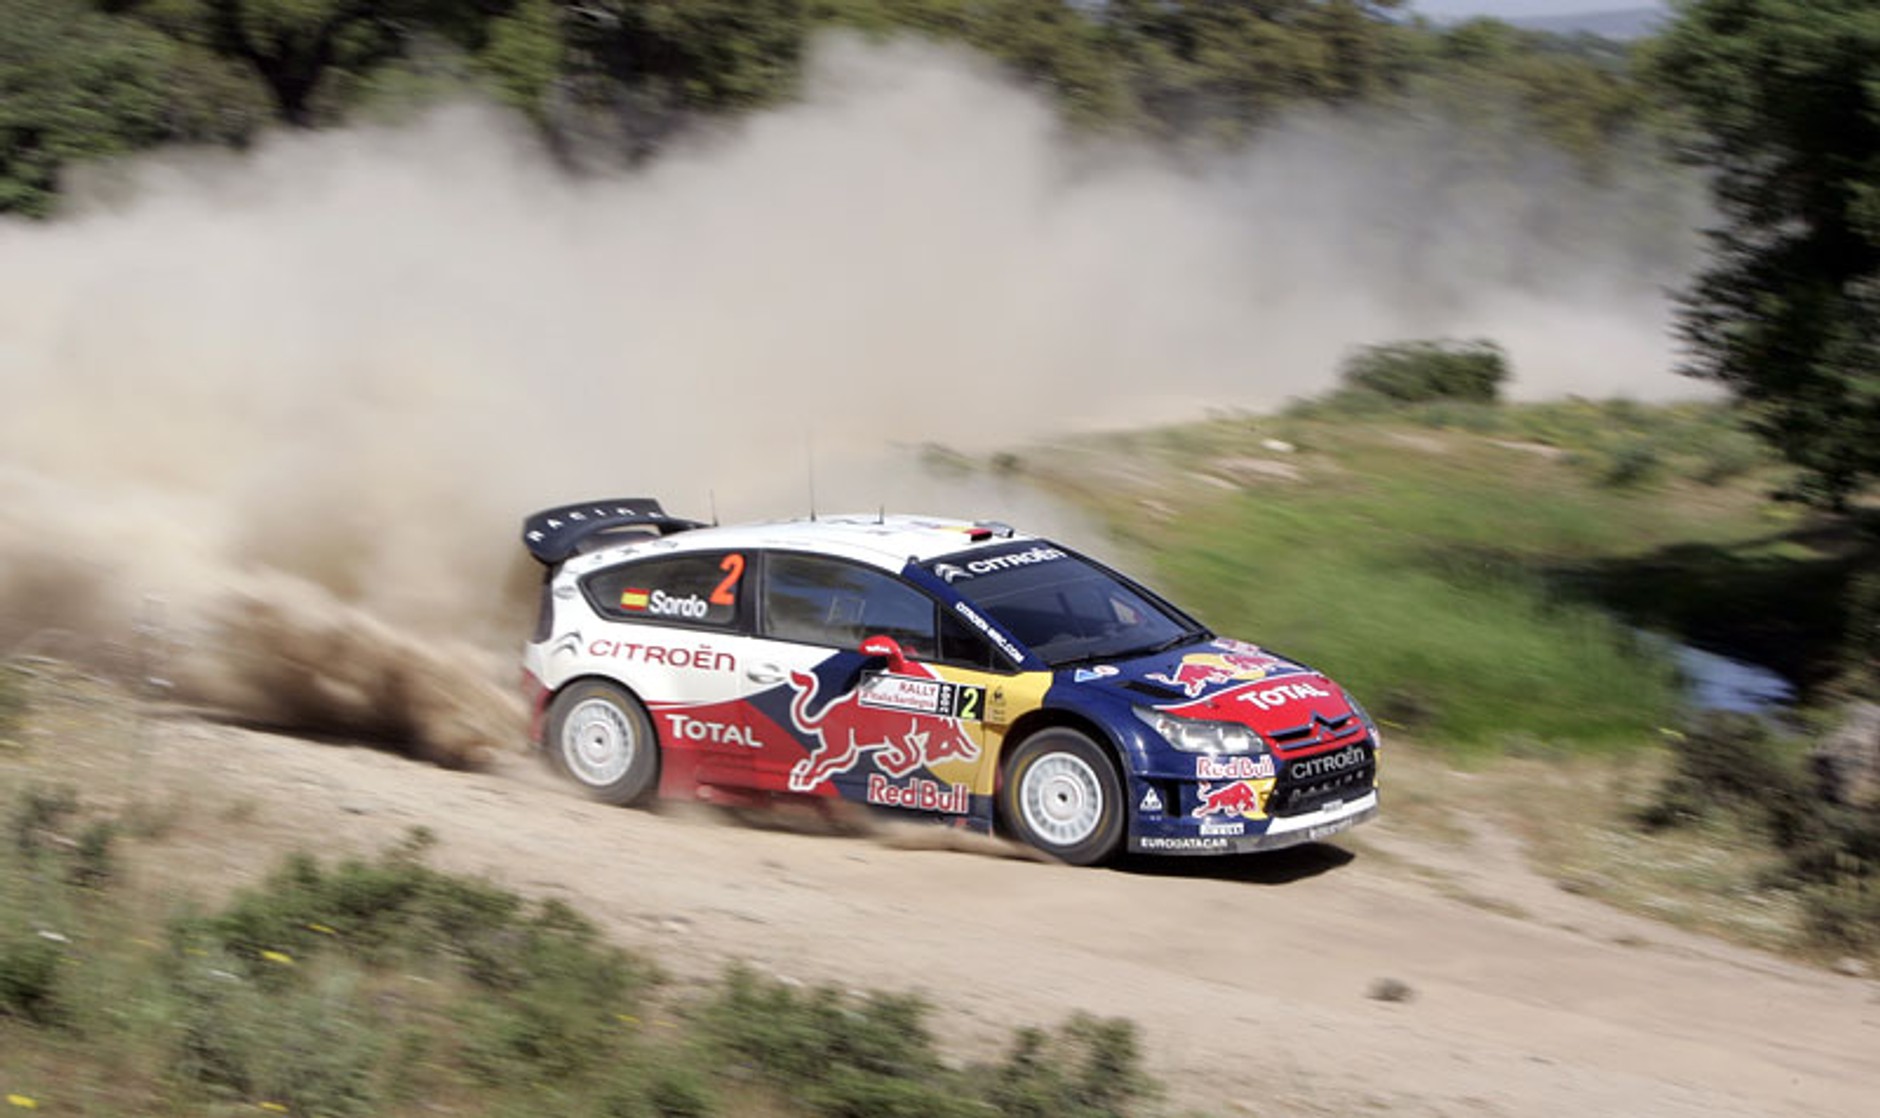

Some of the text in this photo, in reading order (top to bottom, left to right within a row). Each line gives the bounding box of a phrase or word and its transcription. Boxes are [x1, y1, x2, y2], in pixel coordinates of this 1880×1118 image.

[709, 553, 744, 605] 2
[649, 590, 708, 618] Sordo
[589, 639, 736, 672] CITROËN
[900, 681, 937, 697] RALLY
[960, 688, 979, 719] 2
[1237, 682, 1330, 710] TOTAL
[665, 713, 764, 748] TOTAL
[1196, 754, 1275, 778] Red Bull
[1292, 745, 1364, 779] CITROËN
[867, 773, 969, 814] Red Bull
